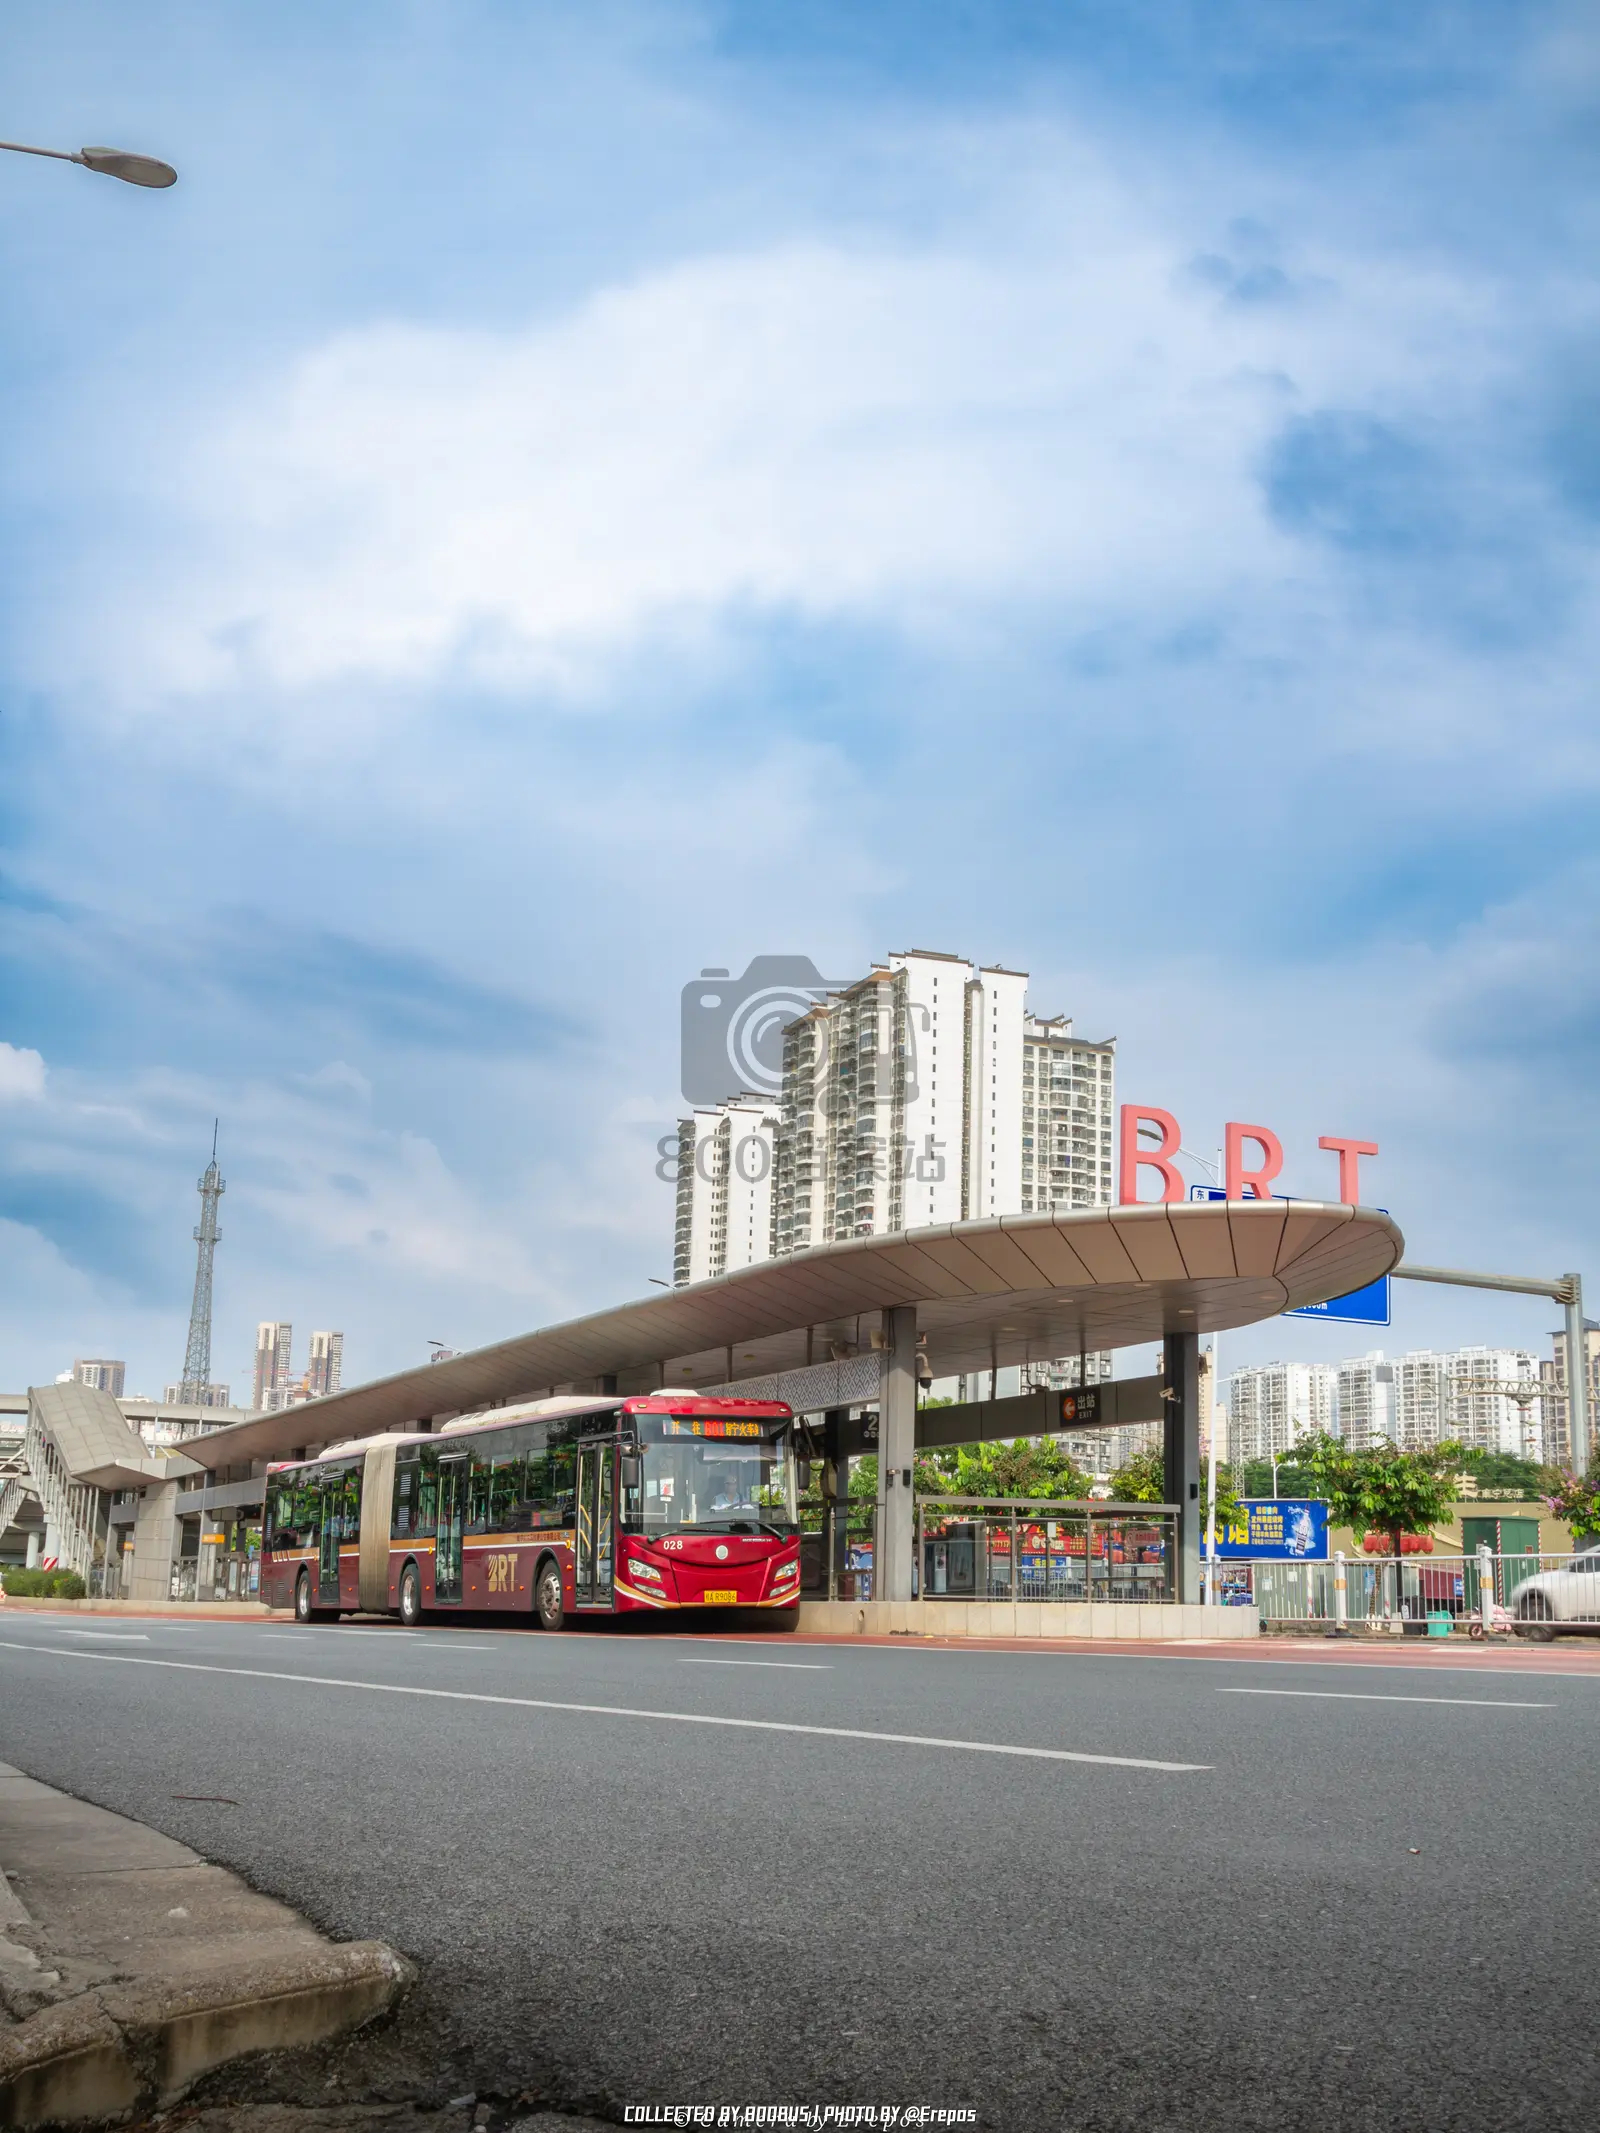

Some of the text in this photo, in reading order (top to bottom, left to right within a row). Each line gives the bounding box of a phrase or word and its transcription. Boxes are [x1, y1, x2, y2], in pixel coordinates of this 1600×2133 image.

[1119, 1104, 1379, 1205] BRT
[1197, 1190, 1205, 1200] 东
[1077, 1394, 1095, 1408] 出站
[1079, 1411, 1092, 1419] EXIT
[663, 1540, 683, 1550] 028
[488, 1553, 518, 1592] BRT
